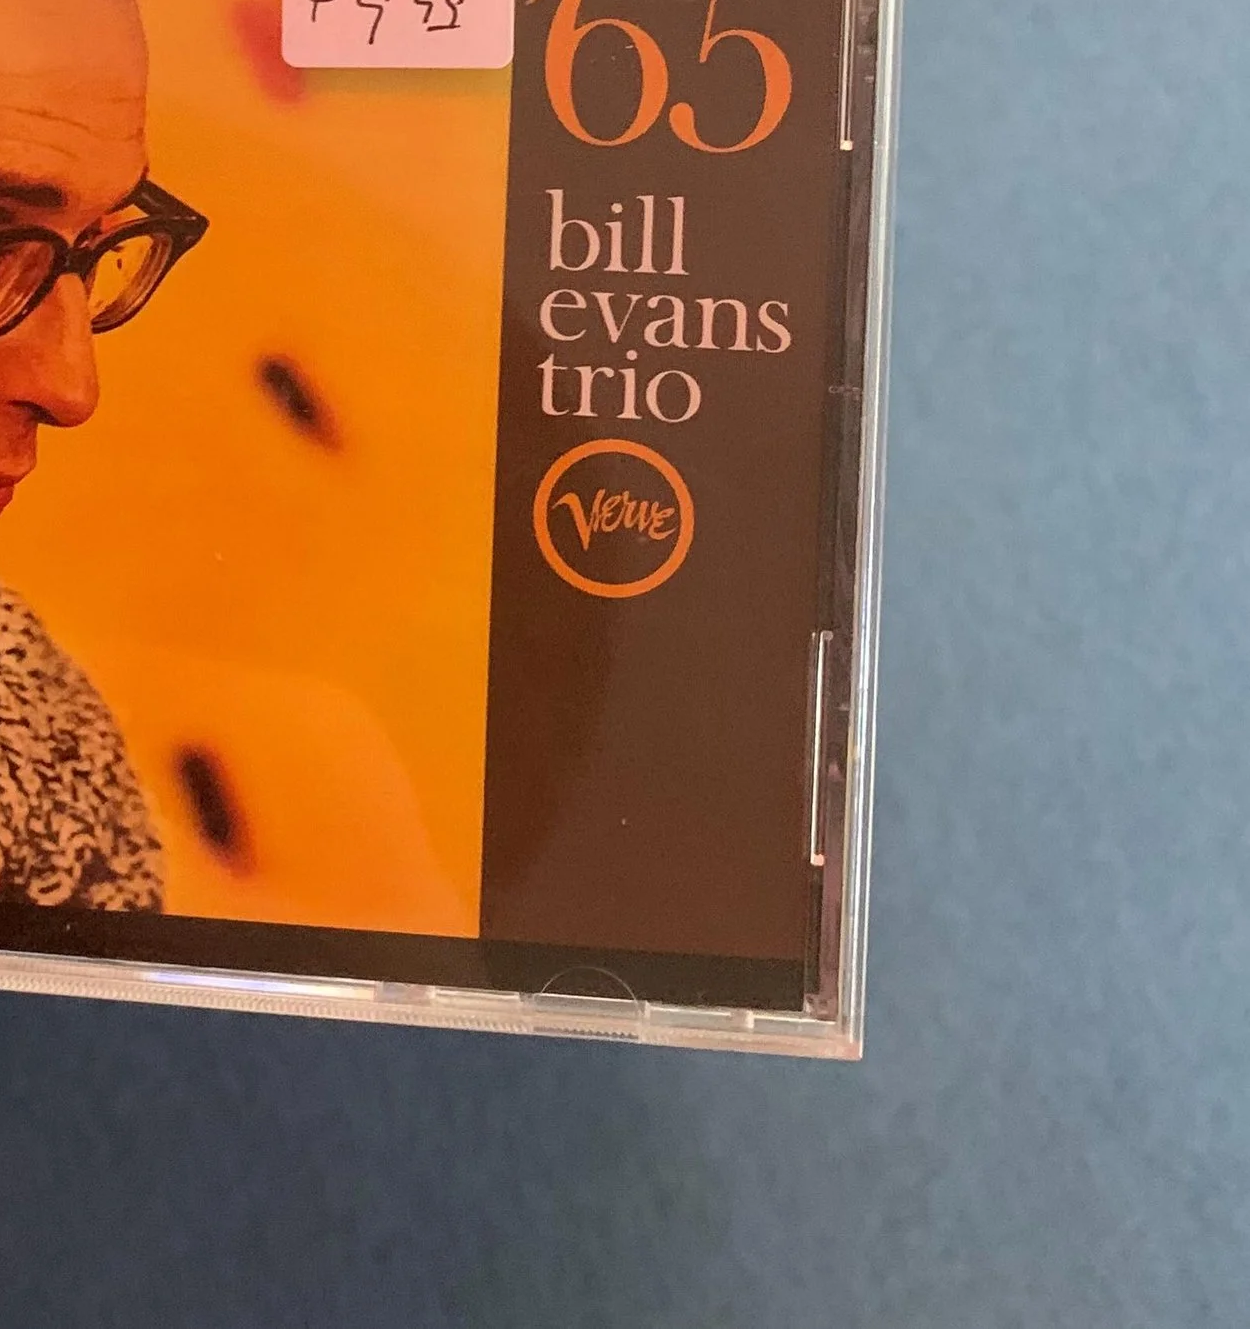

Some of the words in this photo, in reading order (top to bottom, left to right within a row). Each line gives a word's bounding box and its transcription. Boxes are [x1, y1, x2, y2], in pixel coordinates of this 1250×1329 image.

[545, 188, 689, 276] bill
[539, 289, 792, 354] evans
[537, 349, 703, 424] trio
